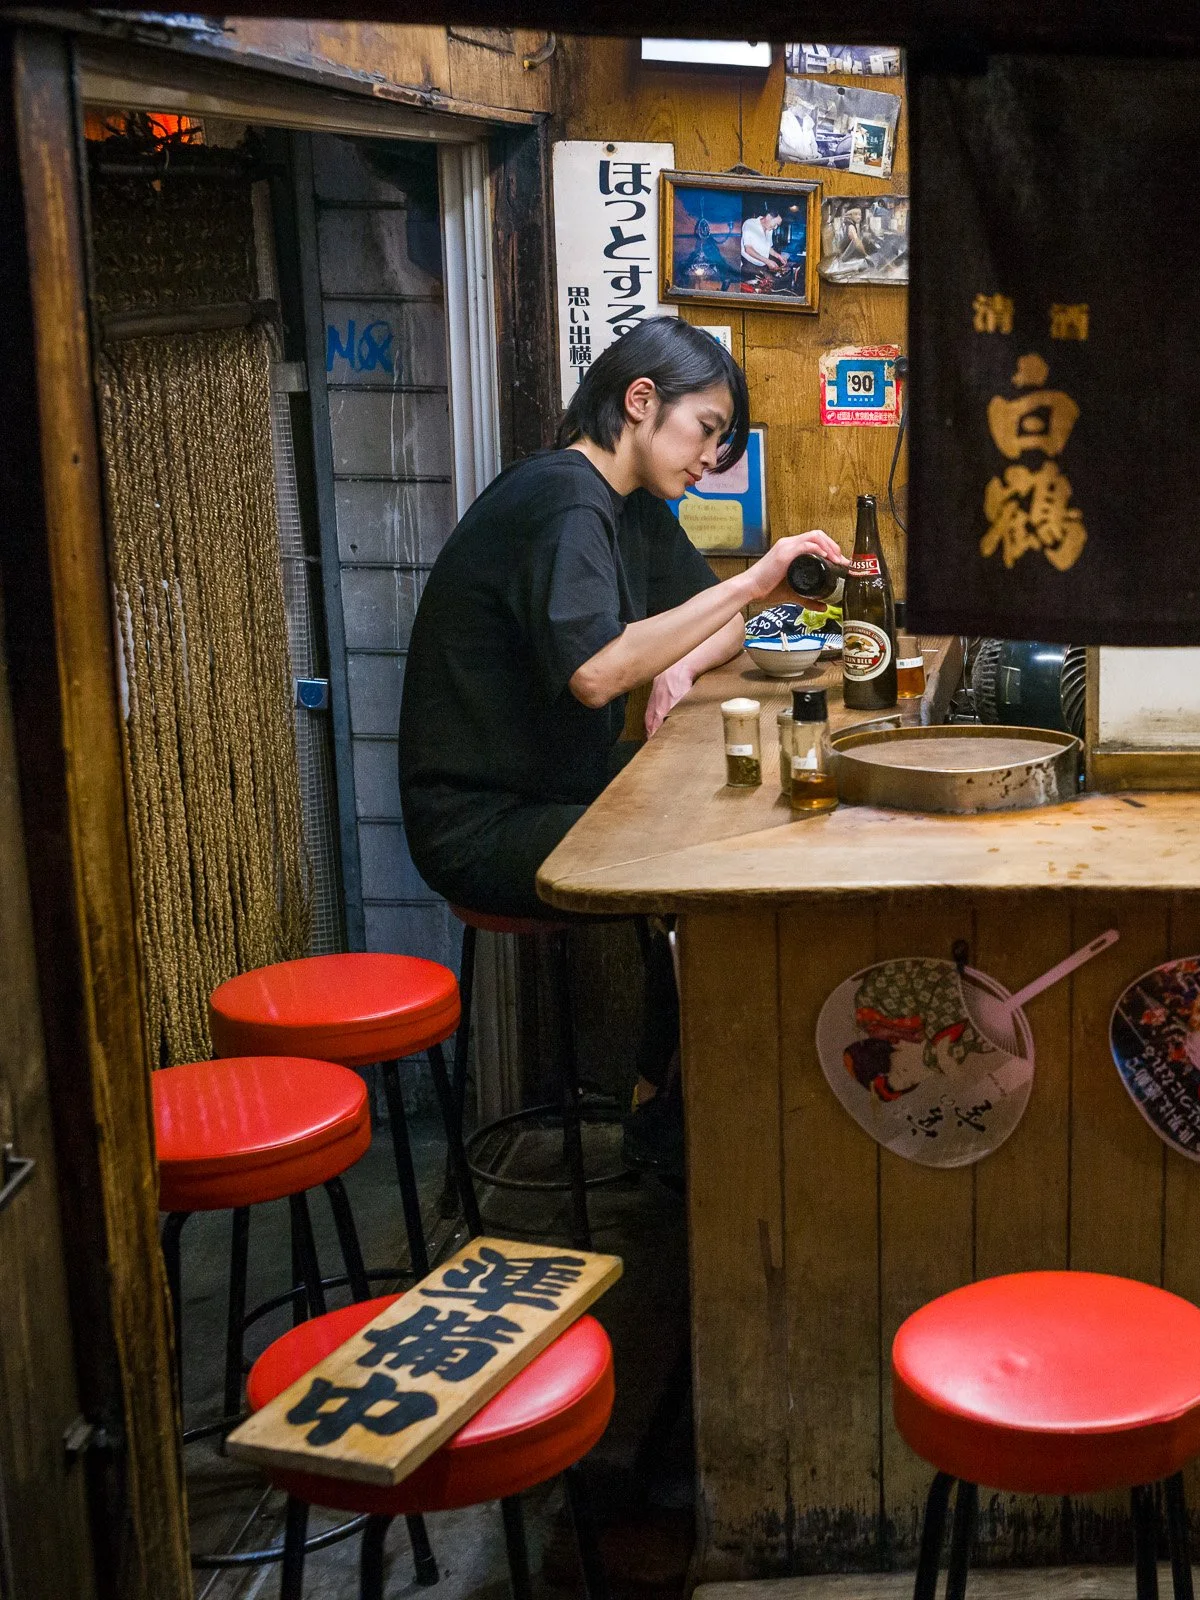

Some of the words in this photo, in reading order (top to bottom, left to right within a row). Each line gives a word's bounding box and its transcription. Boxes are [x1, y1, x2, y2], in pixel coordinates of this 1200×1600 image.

[598, 159, 652, 352] ほっとする
[980, 353, 1088, 572] 白鶴
[849, 560, 875, 569] LASSIC
[285, 1246, 586, 1447] 準備中
